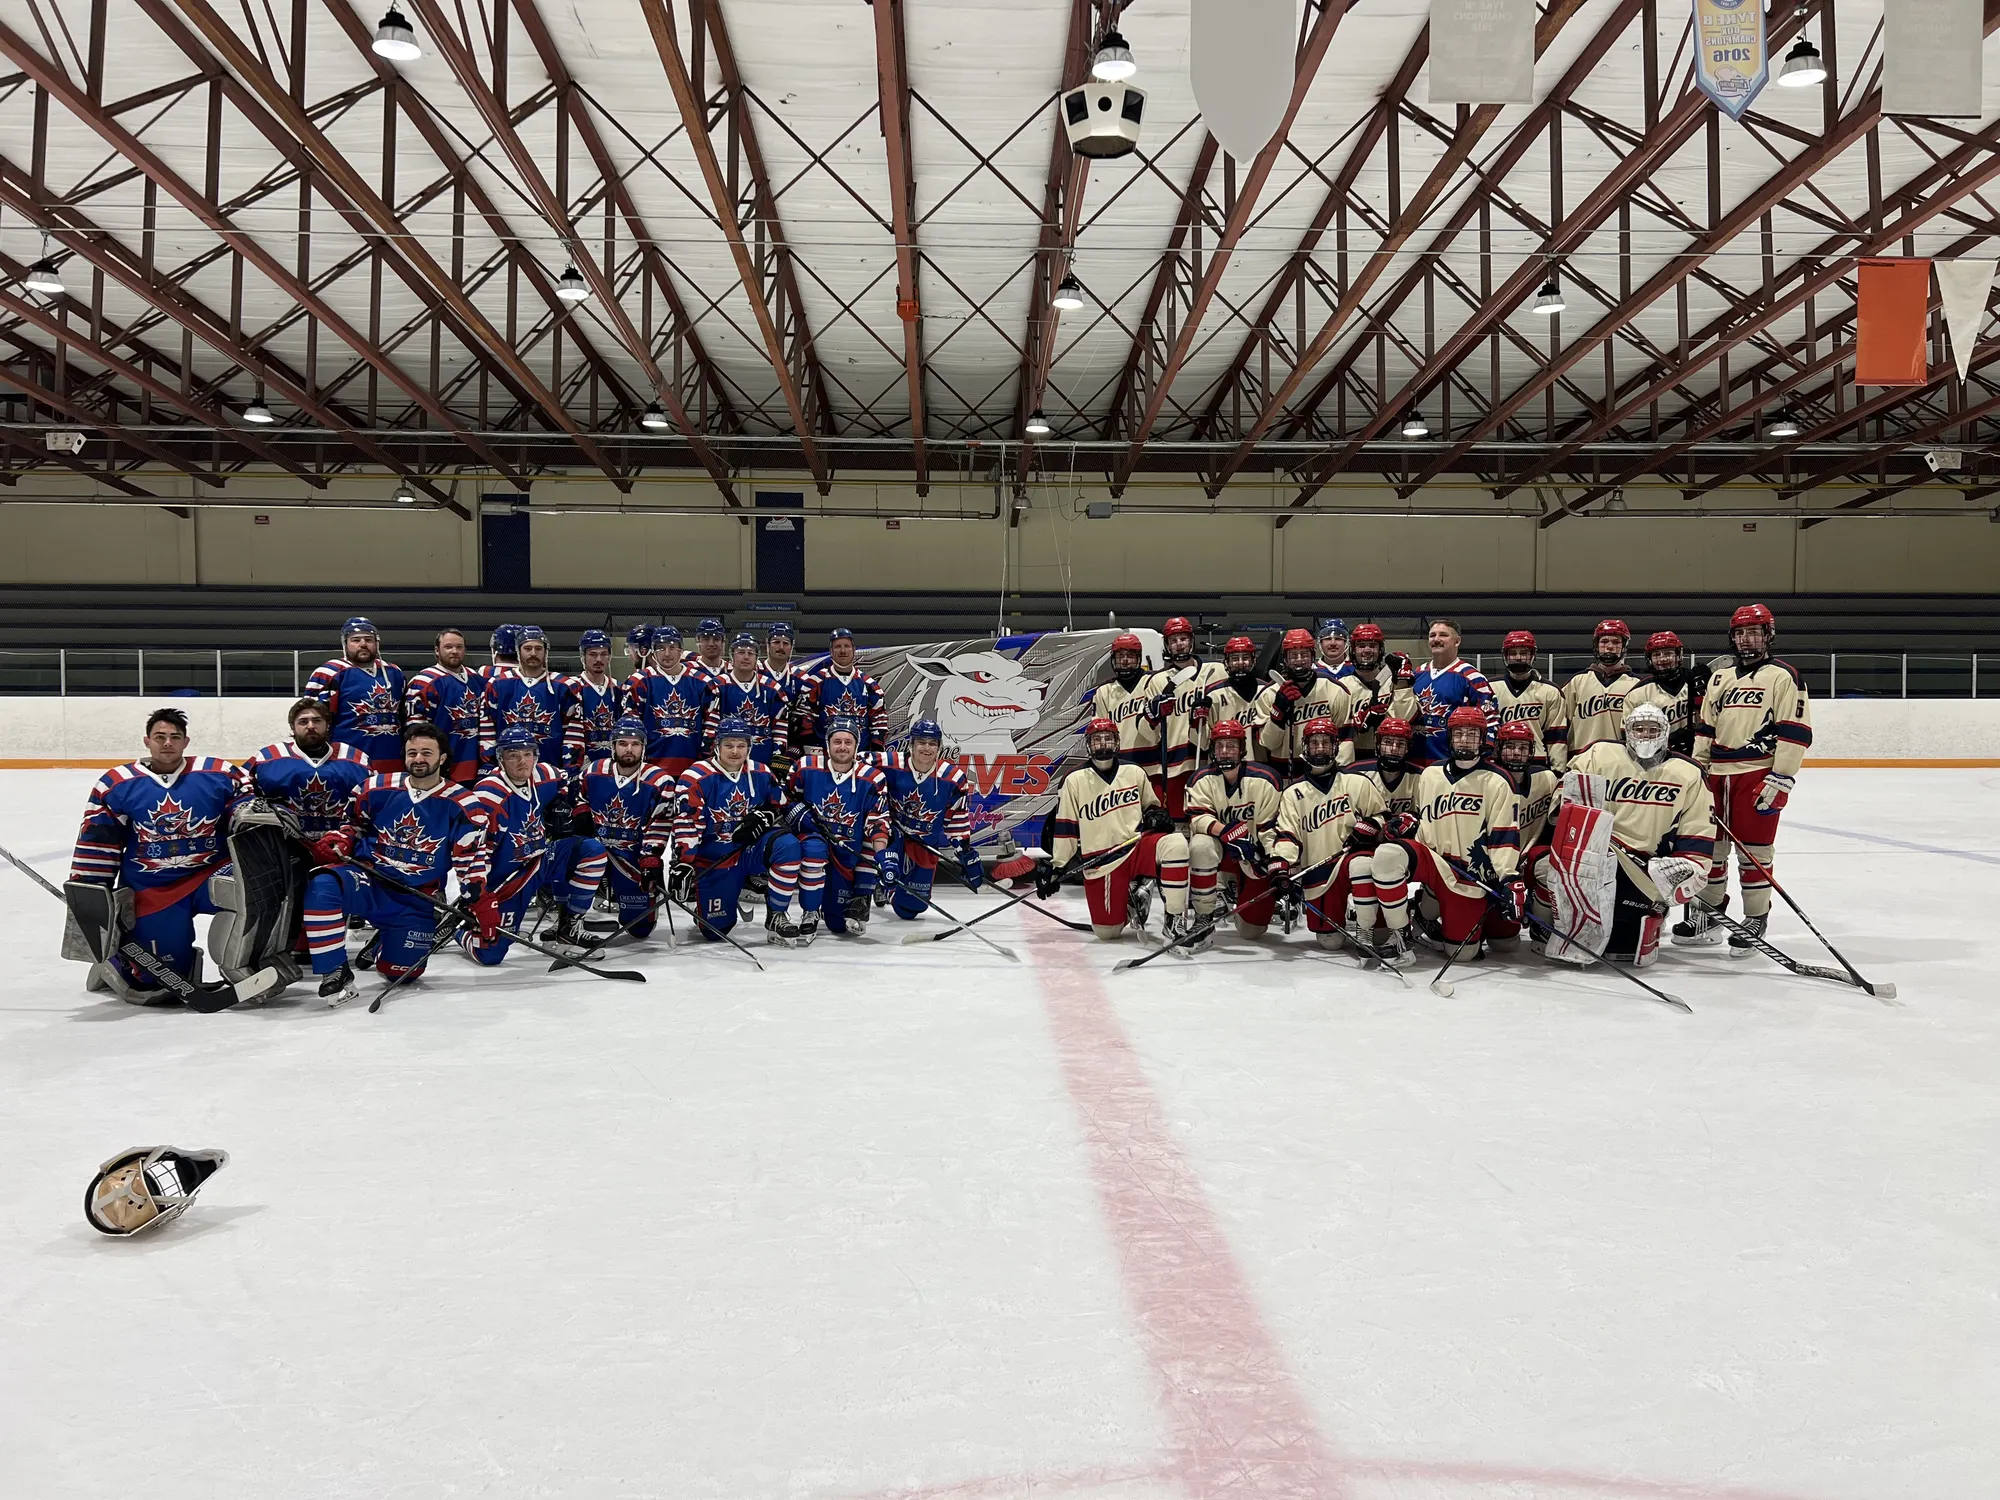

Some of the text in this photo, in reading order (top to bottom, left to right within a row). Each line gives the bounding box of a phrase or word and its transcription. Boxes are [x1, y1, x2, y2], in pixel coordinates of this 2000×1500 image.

[1713, 675, 1722, 686] C
[1221, 695, 1228, 707] A
[1795, 699, 1804, 718] 6
[1294, 789, 1304, 800] A
[1079, 787, 1140, 821] Wolves
[1418, 796, 1483, 823] Wolves
[708, 898, 721, 912] 19
[500, 911, 515, 927] 13
[120, 942, 195, 997] BAUER
